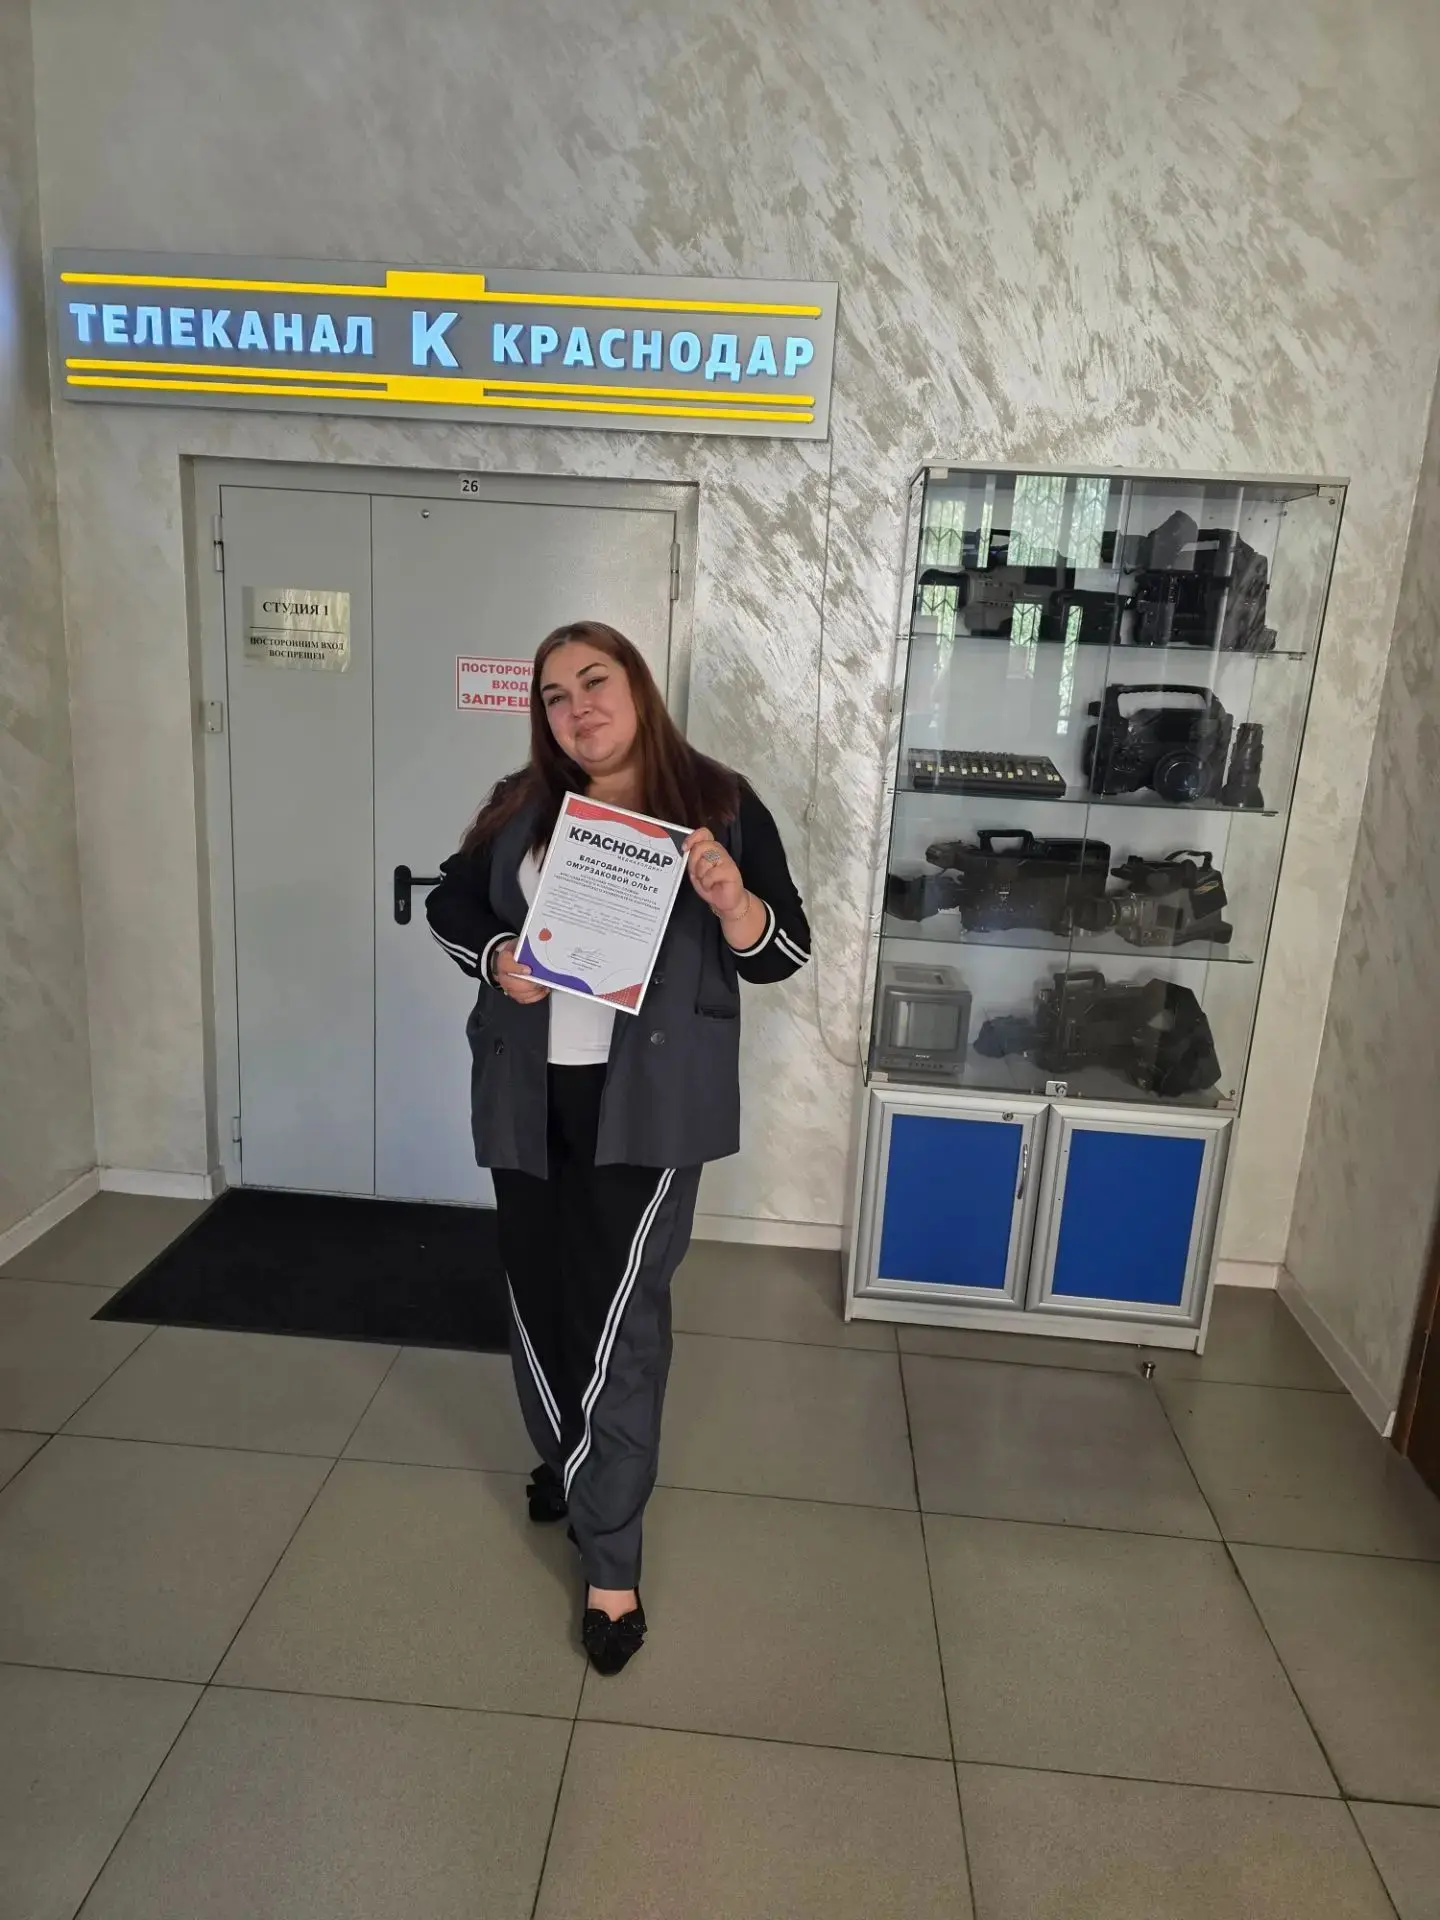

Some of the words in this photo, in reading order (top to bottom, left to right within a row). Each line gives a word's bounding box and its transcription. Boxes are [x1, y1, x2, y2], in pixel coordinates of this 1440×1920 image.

[69, 303, 373, 355] ТЕЛЕКАНАЛ
[412, 311, 461, 367] К
[492, 323, 815, 382] КРАСНОДАР
[462, 479, 479, 492] 26
[262, 601, 319, 616] СТУДИЯ
[324, 605, 329, 616] 1
[250, 636, 319, 649] ПОСТОРОННИМ
[320, 641, 345, 651] ВХОД
[269, 650, 325, 661] ВОСПРЕЩЕН
[461, 662, 535, 676] ПОСТОРОН
[492, 680, 529, 692] ВХОД
[461, 693, 530, 707] ЗАПРЕЩ
[569, 826, 673, 868] КРАСНОДАР
[579, 854, 650, 882] БЛАГОДАРНОСТЬ
[566, 860, 629, 885] ОМУРЗАКОВОЙ
[631, 881, 659, 894] ОЛЬГЕ
